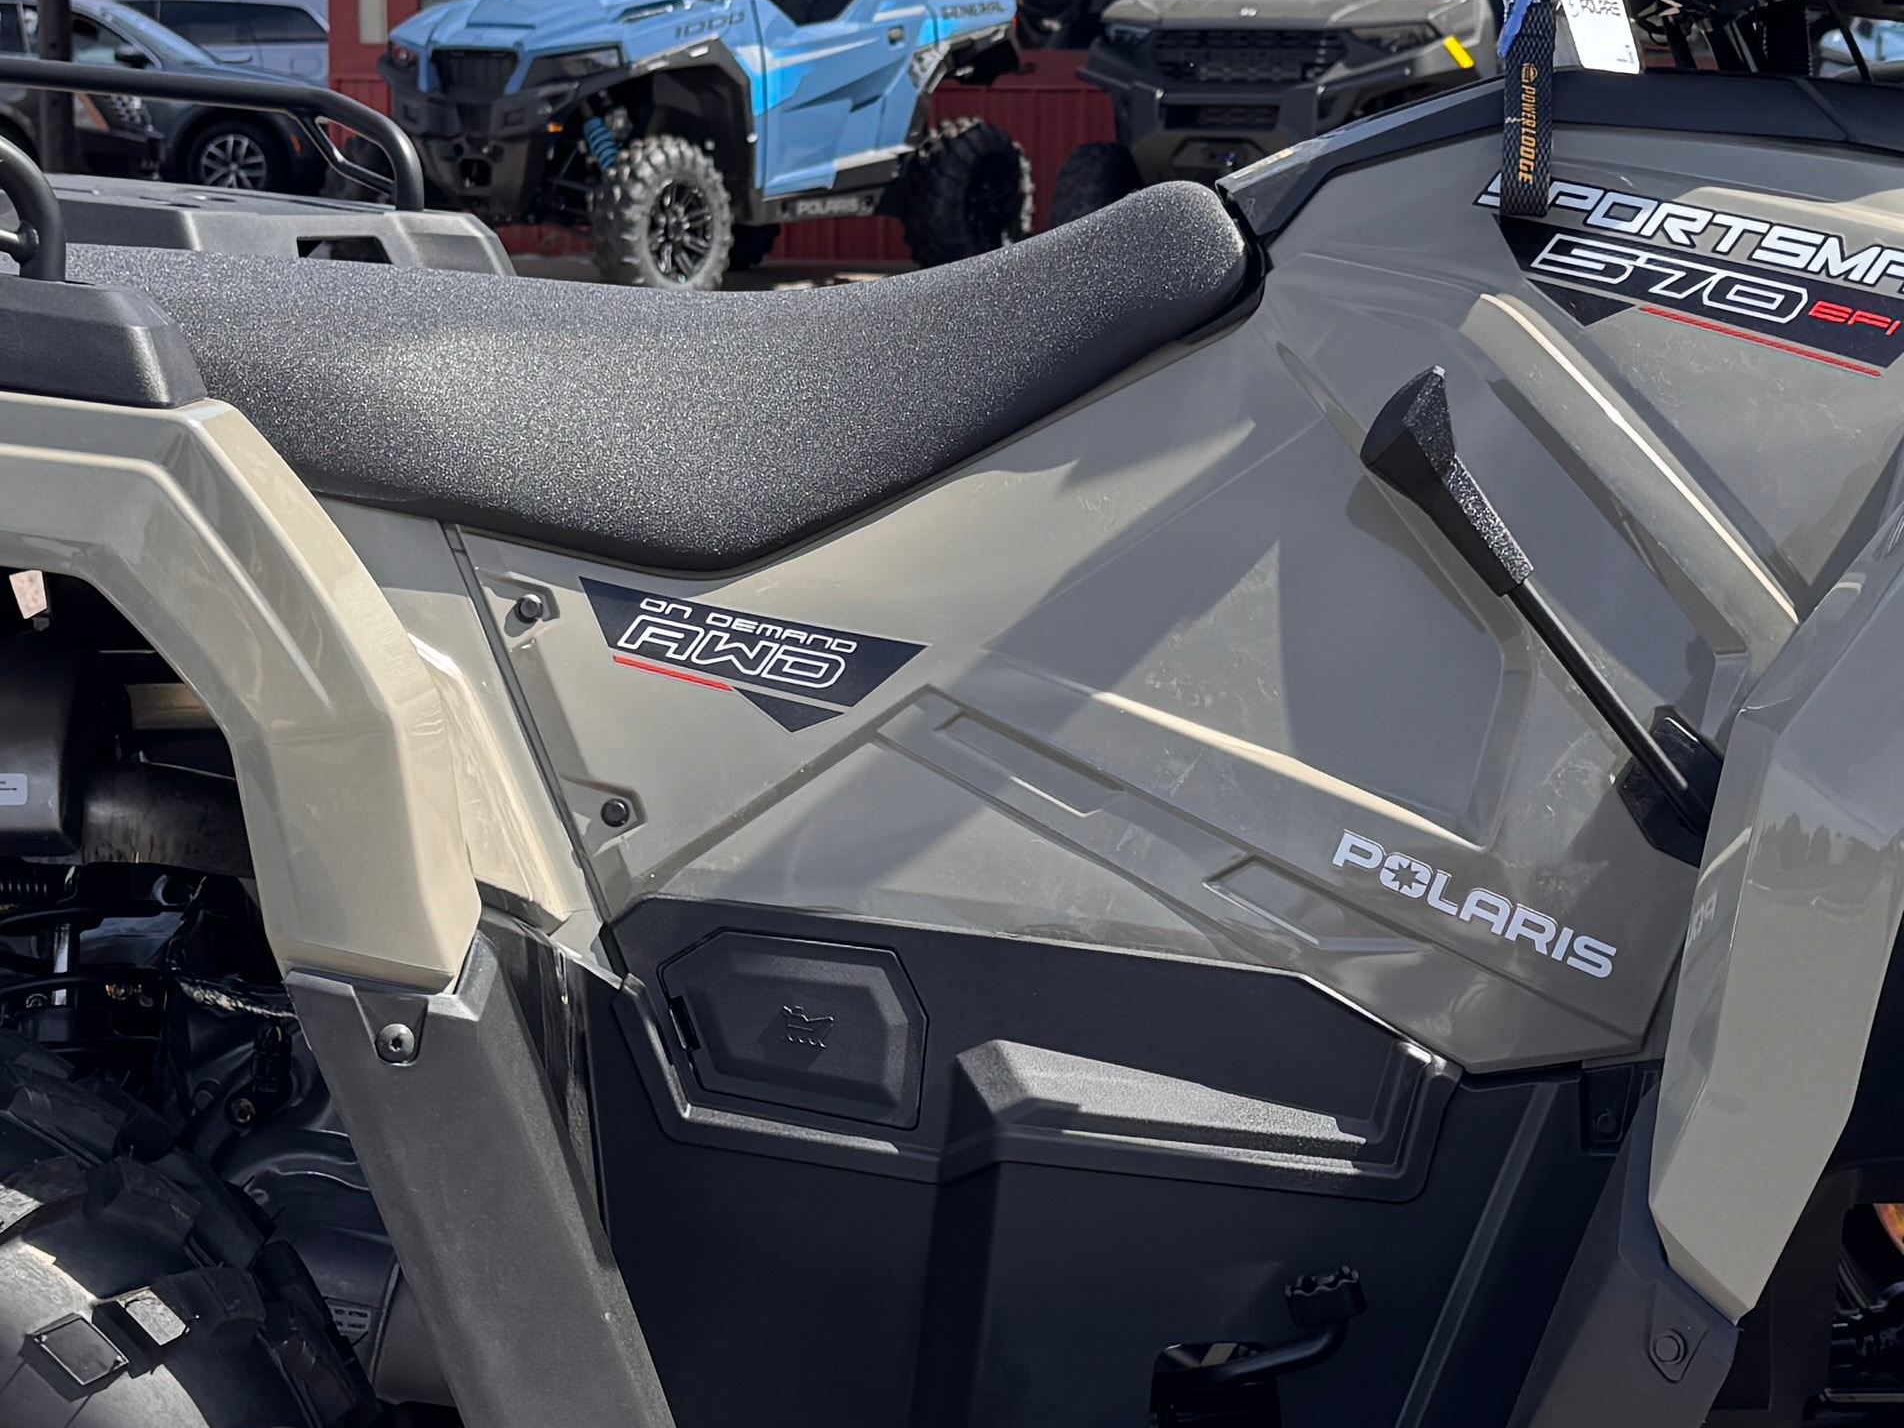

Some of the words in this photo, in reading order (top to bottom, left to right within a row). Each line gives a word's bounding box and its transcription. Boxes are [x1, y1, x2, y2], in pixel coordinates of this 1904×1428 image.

[675, 12, 745, 38] 1000
[797, 197, 859, 215] POLARIS
[1530, 233, 1809, 324] 570
[1807, 299, 1902, 336] EFI
[617, 614, 846, 689] AWD
[639, 598, 693, 618] ON
[705, 612, 858, 654] DEMAND
[1332, 829, 1617, 978] POLARIS
